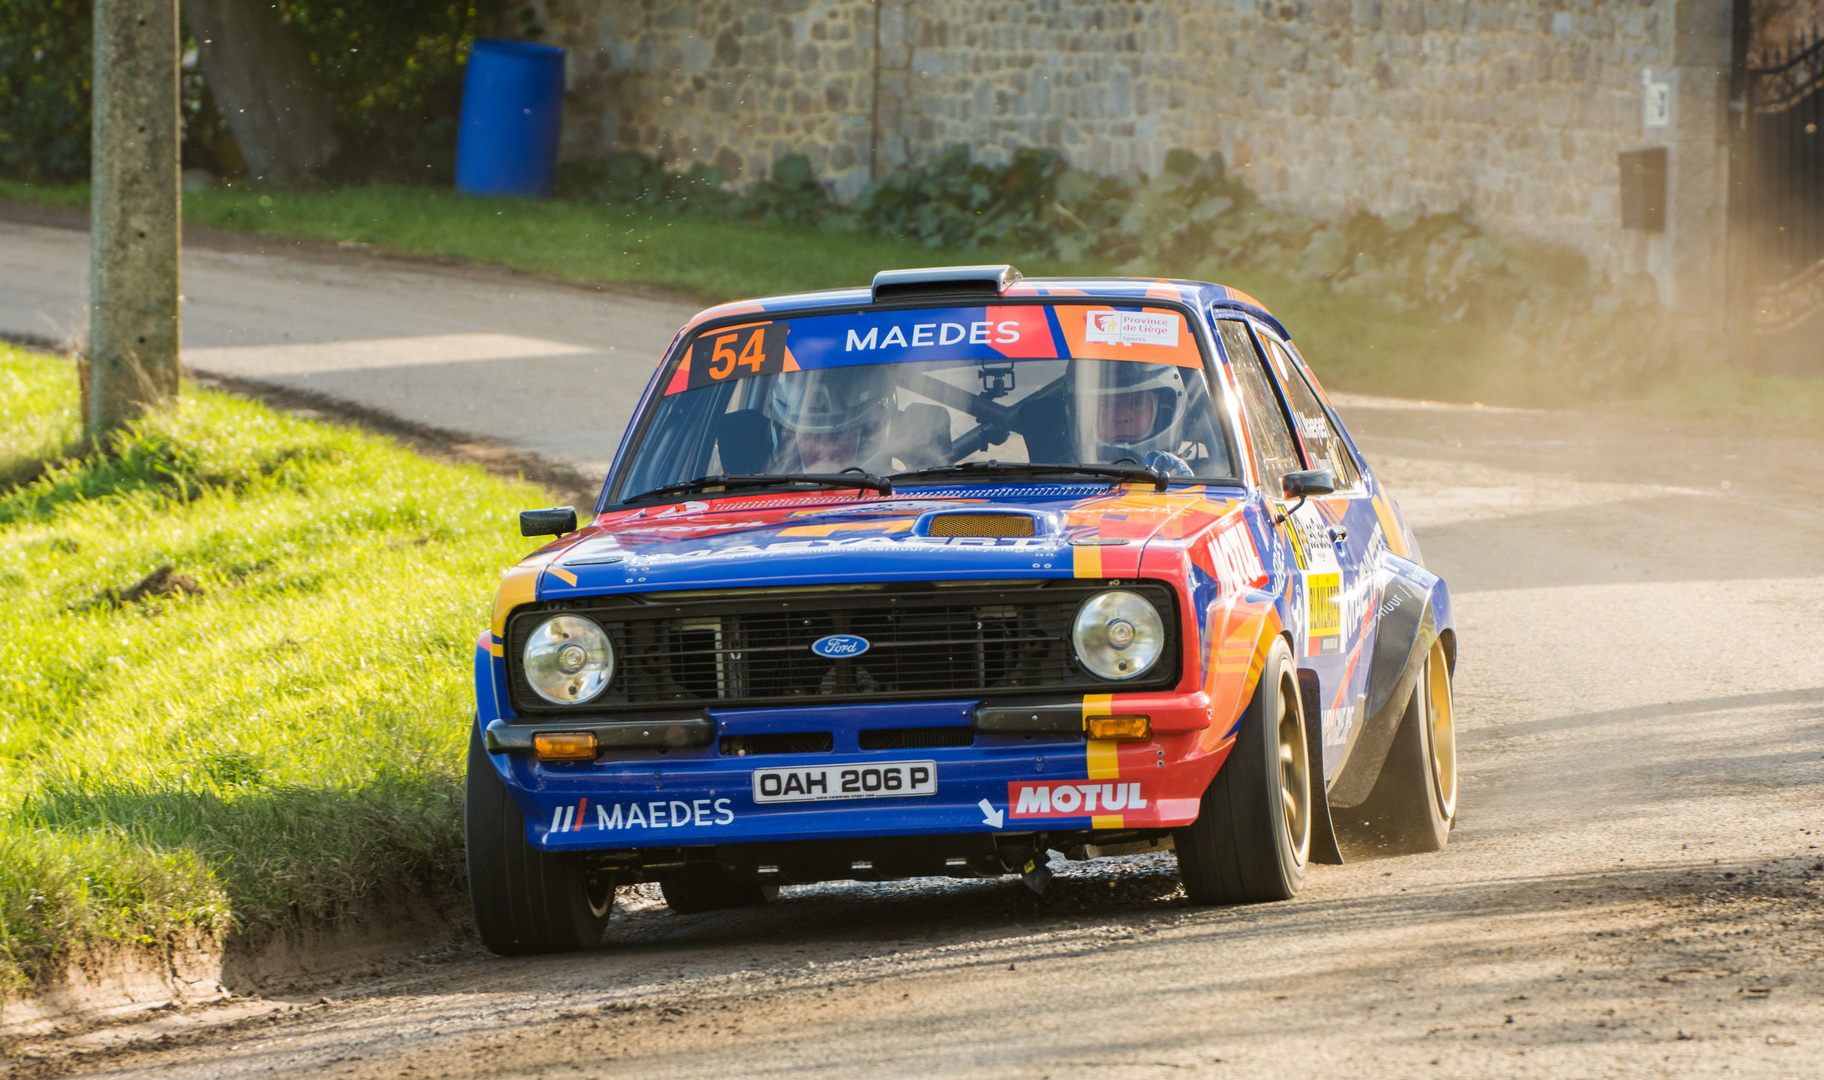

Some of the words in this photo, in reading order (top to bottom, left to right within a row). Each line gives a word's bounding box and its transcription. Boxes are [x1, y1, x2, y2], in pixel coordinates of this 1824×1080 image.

[844, 321, 1021, 351] MAEDES
[1123, 316, 1168, 326] Province
[1139, 325, 1168, 335] Liège
[708, 327, 766, 380] 54
[1207, 521, 1265, 598] MOTUL
[824, 638, 858, 653] Ford
[760, 771, 828, 797] OAH
[840, 767, 903, 793] 206
[909, 766, 930, 790] P
[1015, 782, 1147, 813] MOTUL
[597, 798, 736, 831] MAEDES
